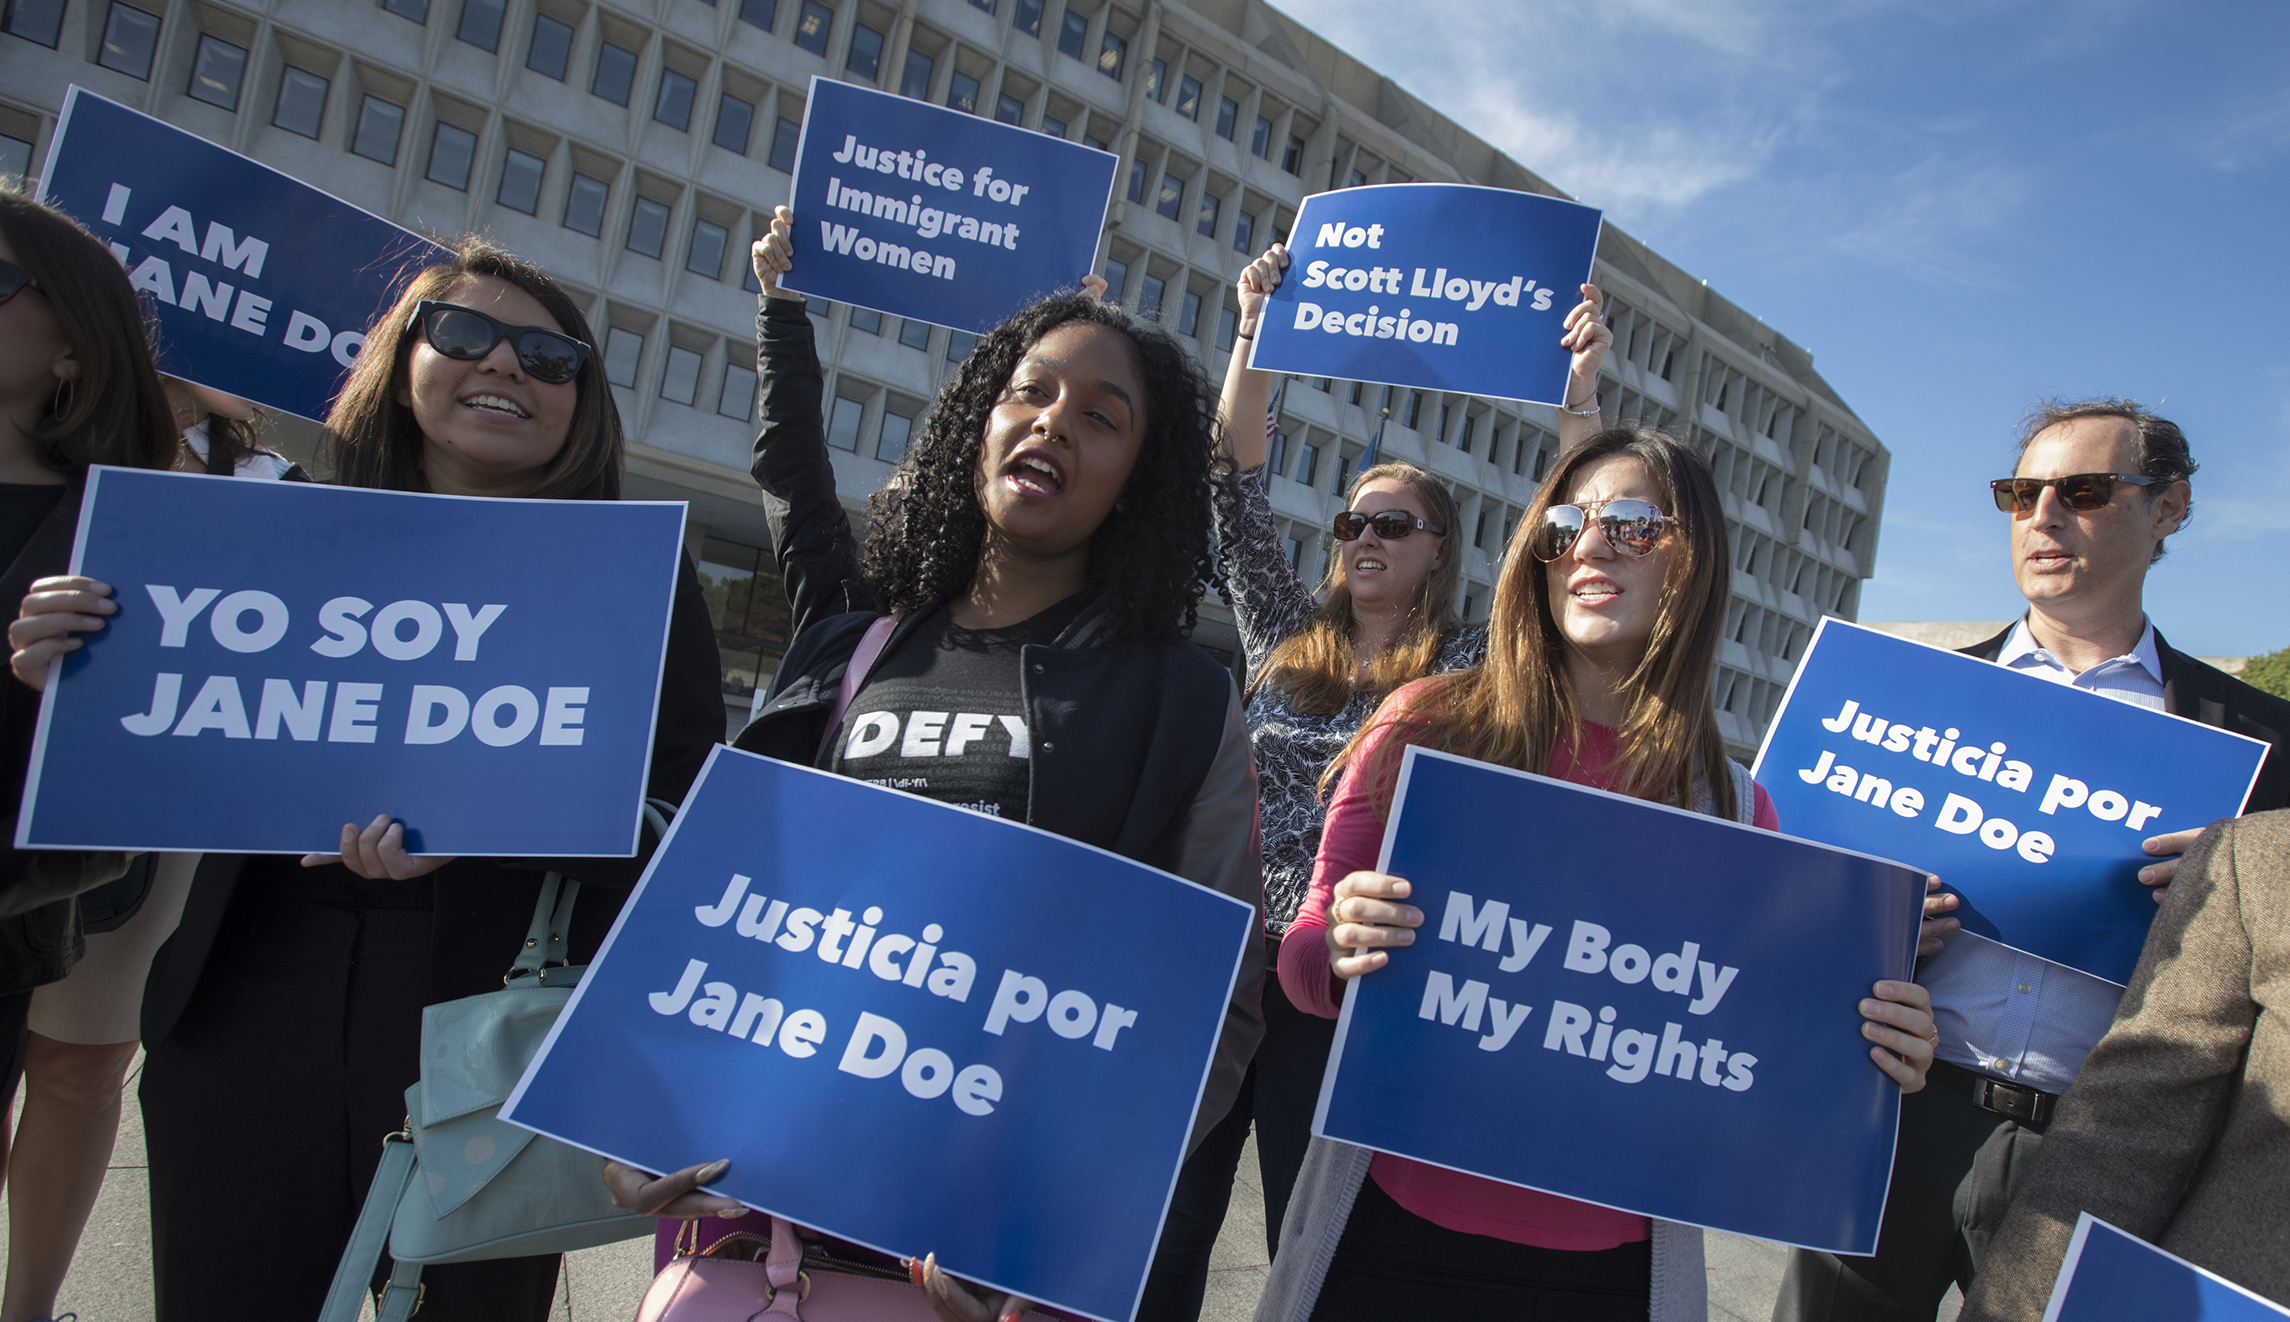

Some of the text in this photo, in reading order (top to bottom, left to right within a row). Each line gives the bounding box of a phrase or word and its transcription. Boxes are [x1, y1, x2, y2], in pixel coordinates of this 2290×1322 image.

[832, 134, 1030, 206] Justice for
[101, 182, 269, 279] I AM
[821, 220, 956, 281] Women
[826, 176, 1020, 251] Immigrant
[1315, 221, 1385, 250] Not
[1302, 259, 1555, 312] Scott Lloyd's
[283, 309, 367, 371] DO
[1293, 301, 1460, 347] Decision
[145, 584, 508, 662] YO SOY
[120, 672, 590, 746] JANE DOE
[843, 710, 1030, 760] DEFY
[1821, 699, 2163, 832] Justicia por
[1798, 750, 2056, 864] Jane Doe
[694, 873, 1139, 1052] Justicia por
[1438, 890, 1740, 1016] My Body
[648, 958, 1003, 1116] Jane Doe
[1418, 970, 1759, 1092] My Rights
